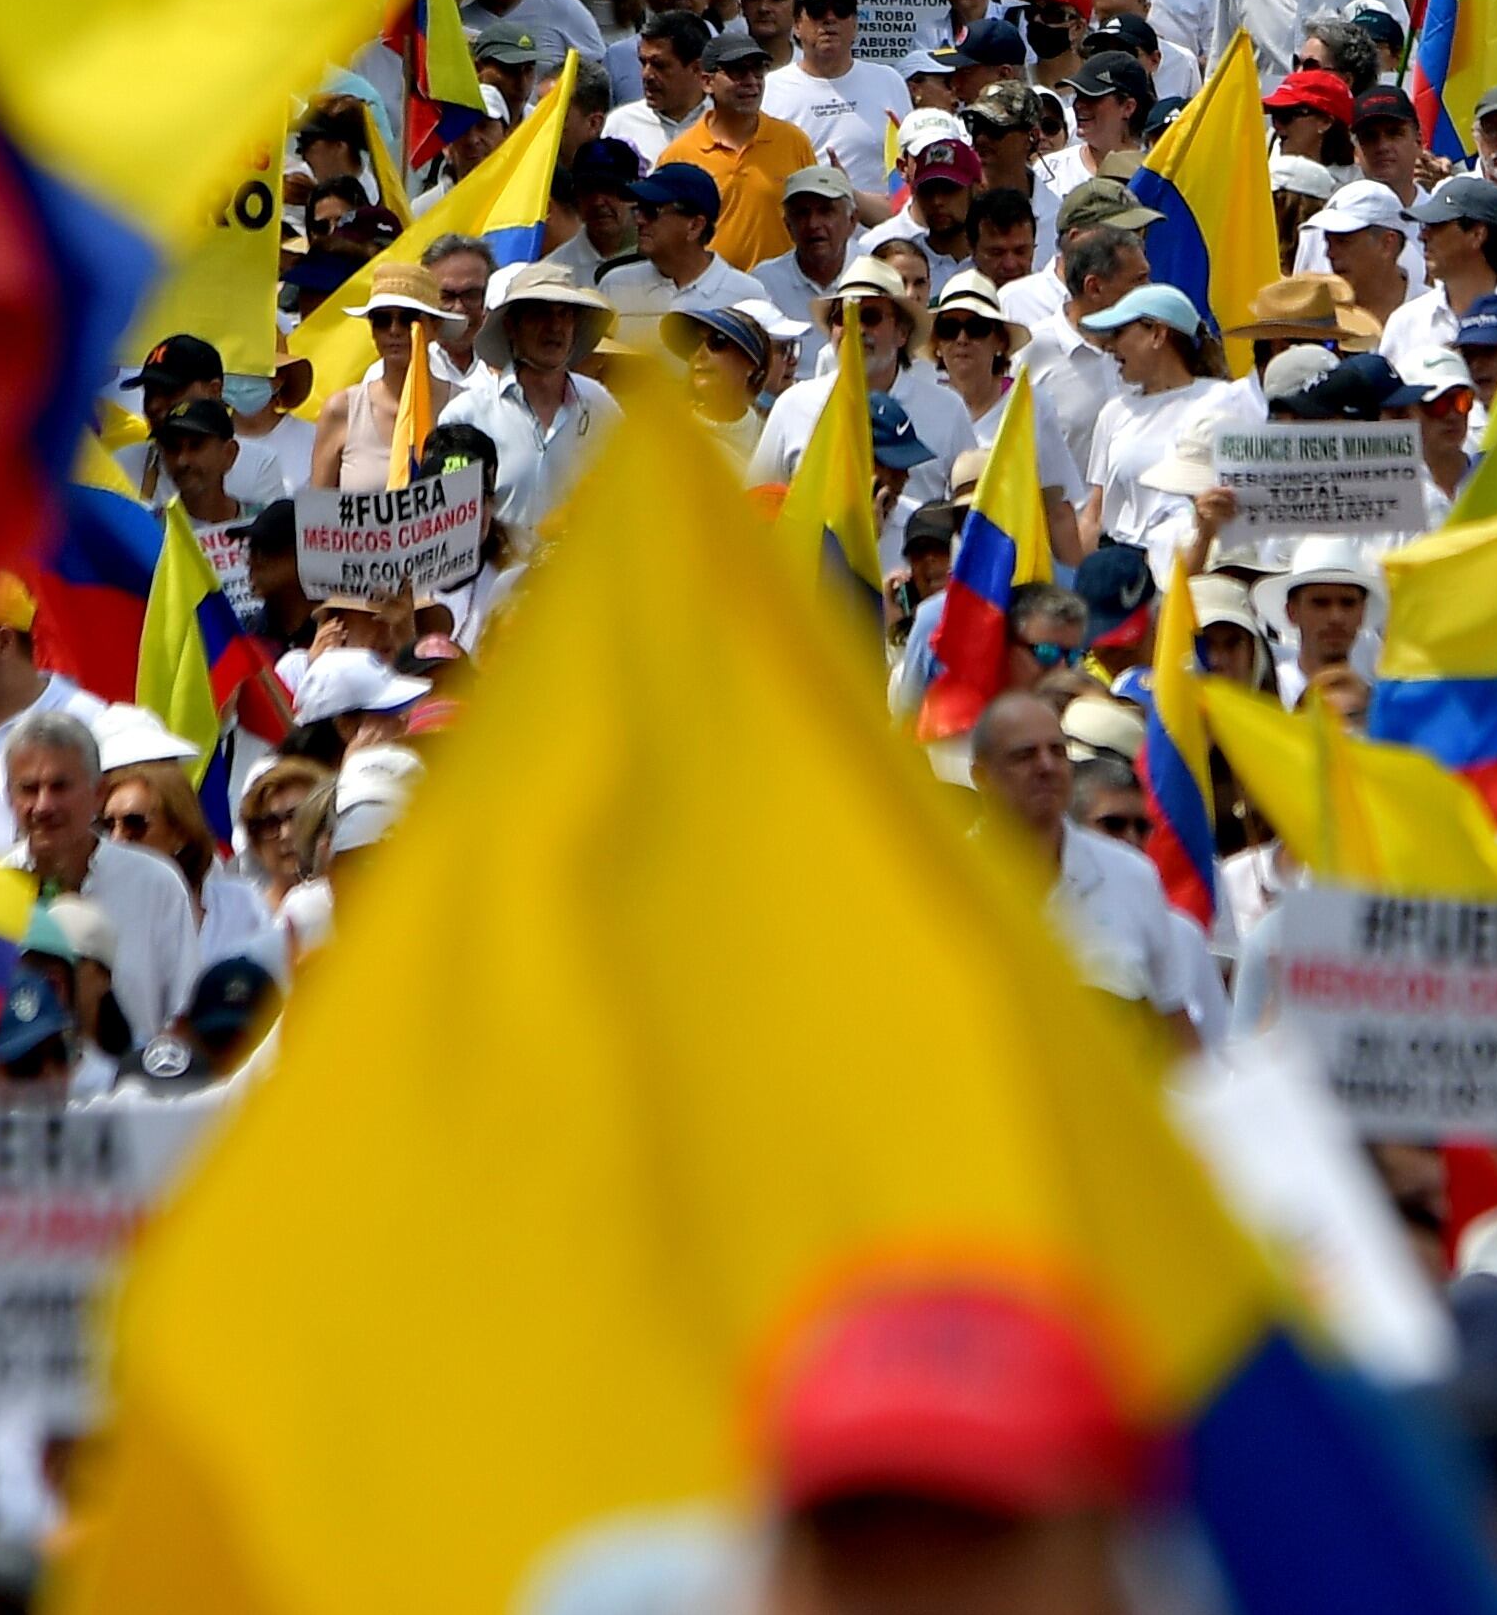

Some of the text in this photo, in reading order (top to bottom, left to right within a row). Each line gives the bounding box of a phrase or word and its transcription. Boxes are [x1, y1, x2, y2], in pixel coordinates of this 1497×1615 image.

[874, 10, 915, 23] ROBO
[851, 48, 909, 59] ENDERO
[338, 478, 447, 528] #FUERA
[303, 498, 478, 554] MÉDICOS CUBANOS
[341, 541, 448, 583] EN COLOMBIA
